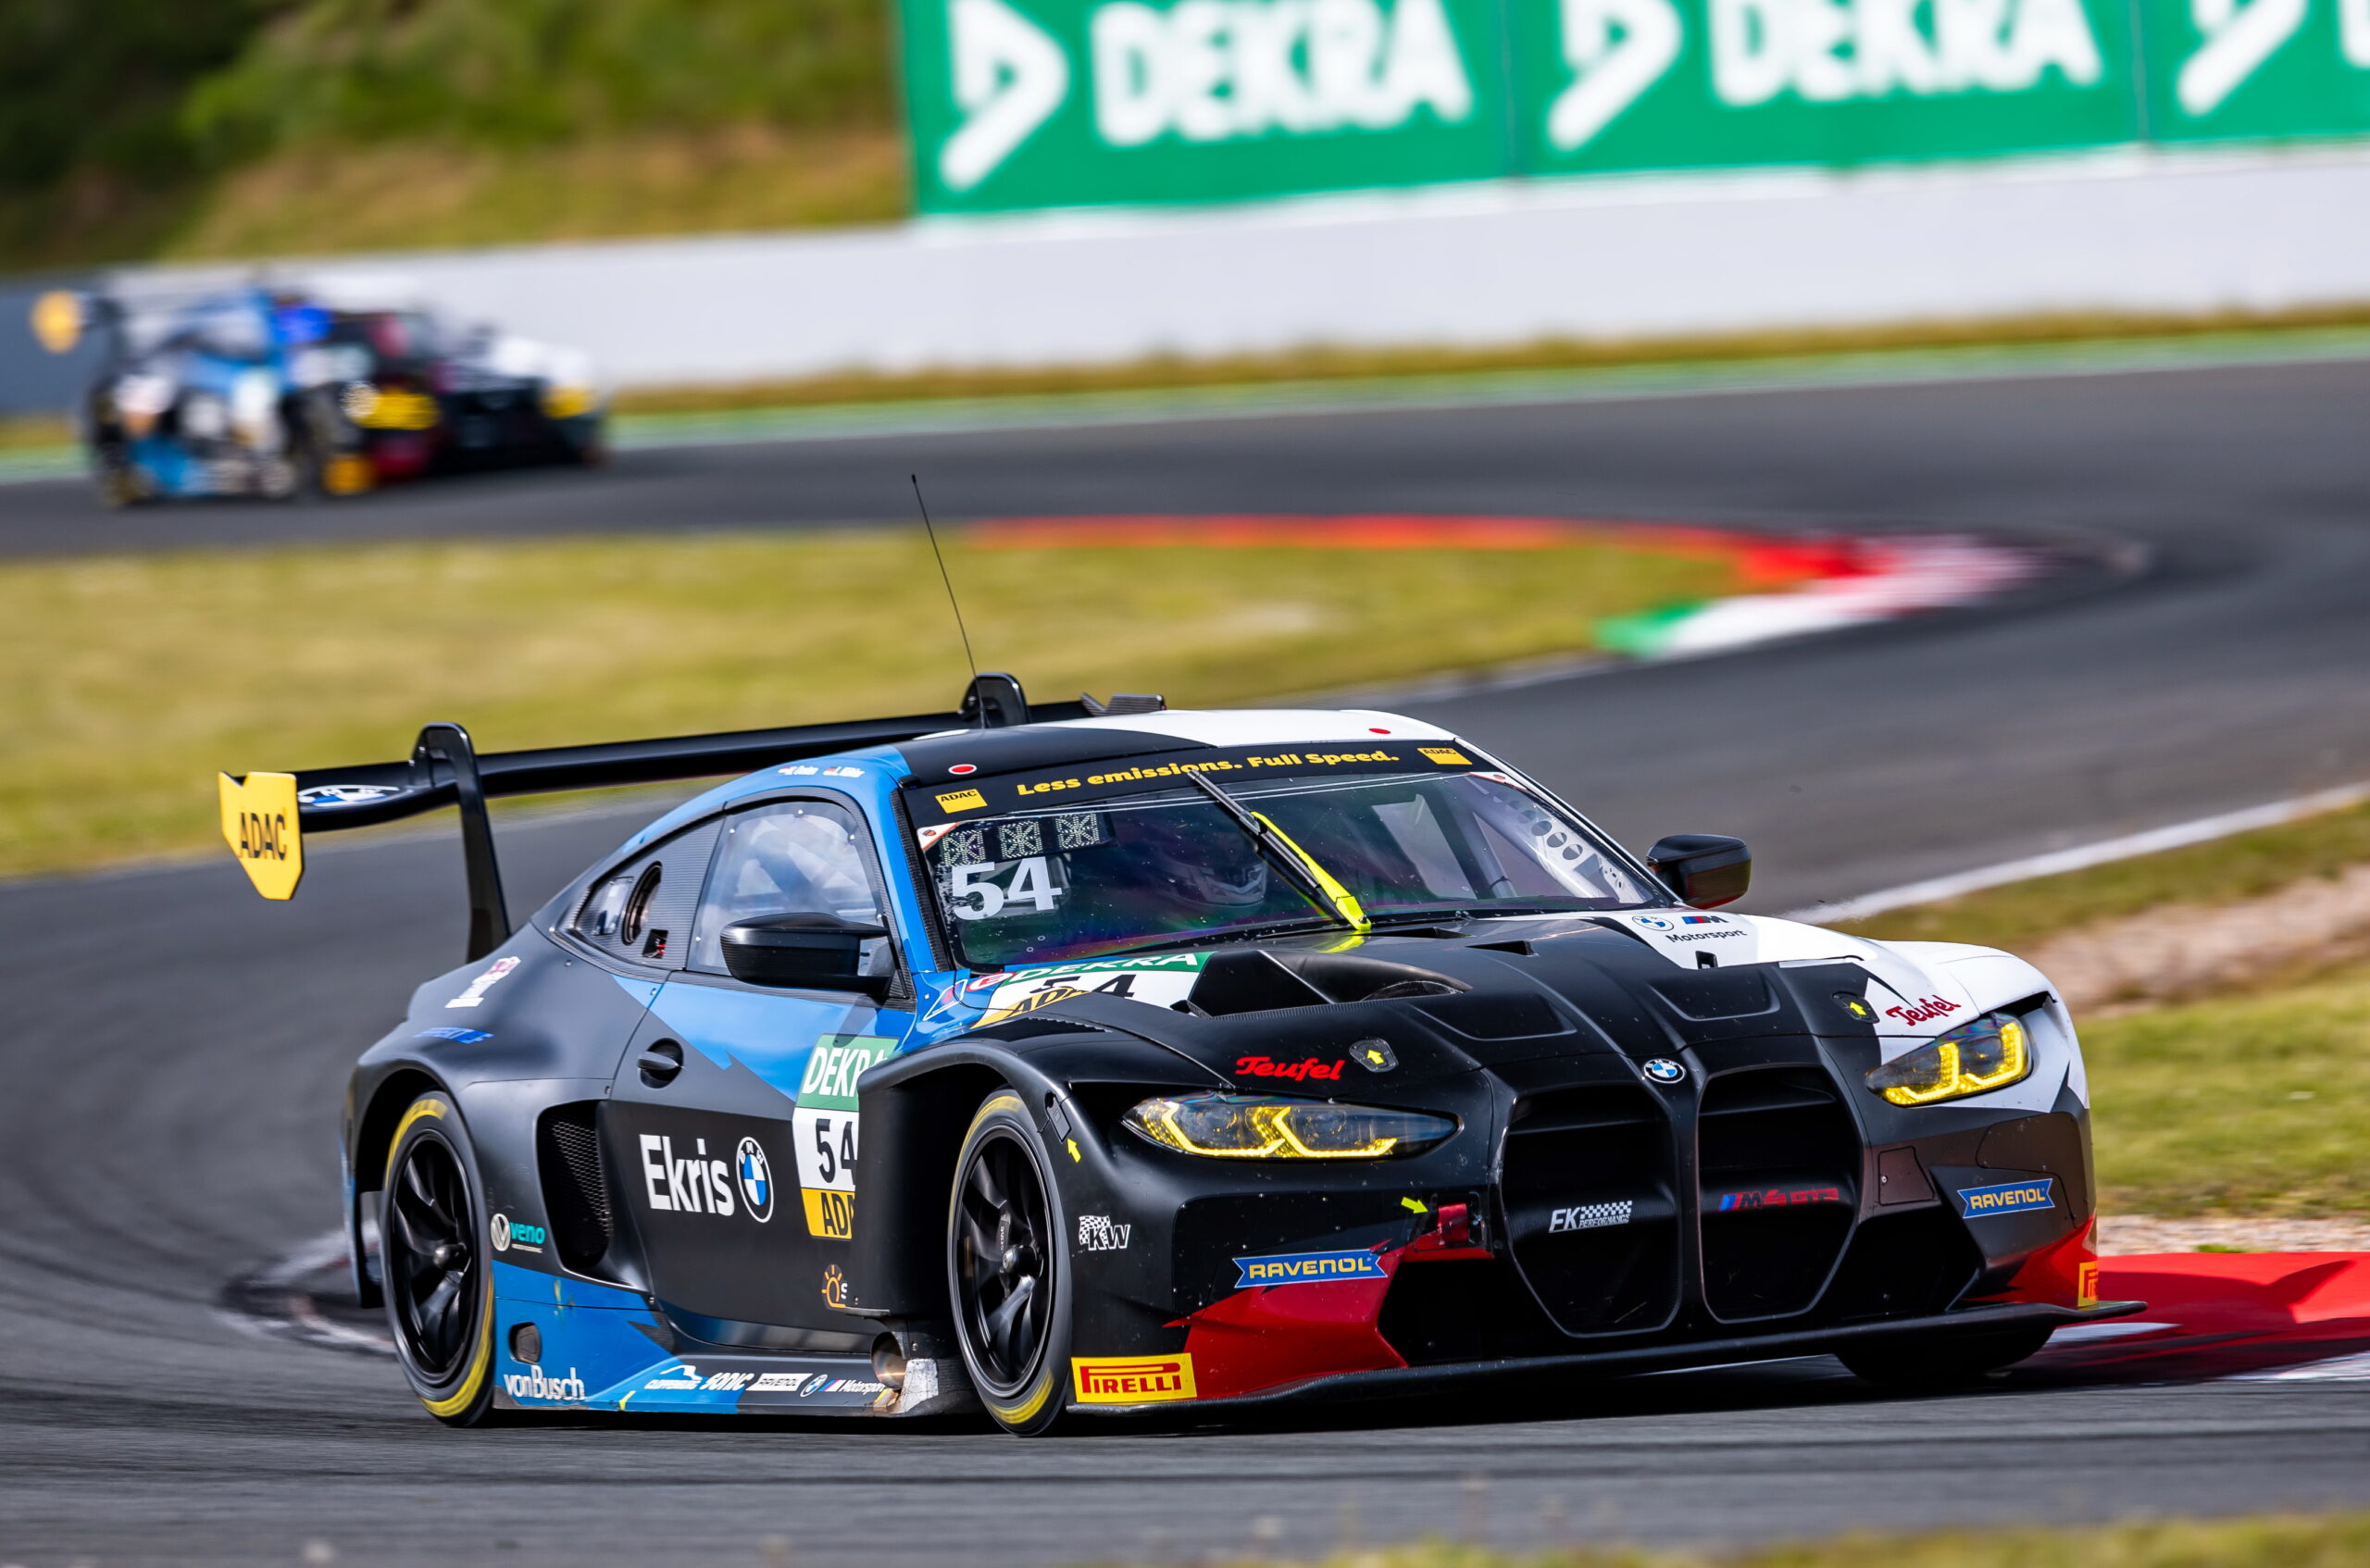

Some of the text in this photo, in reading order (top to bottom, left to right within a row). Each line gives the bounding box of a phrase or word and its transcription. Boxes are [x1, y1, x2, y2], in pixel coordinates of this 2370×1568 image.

[1709, 0, 2103, 106] DEKRA
[1091, 0, 1472, 144] DEKRA
[1016, 750, 1400, 796] Less emissions. Full Speed.
[940, 790, 979, 803] ADAC
[239, 812, 287, 862] ADAC
[952, 856, 1063, 921] 54
[1665, 929, 1748, 943] Motorsport
[1009, 952, 1198, 982] DEKRA
[1029, 973, 1137, 1000] 54
[1885, 994, 1961, 1027] Teufel
[801, 1046, 889, 1098] DEKR
[1235, 1056, 1346, 1081] Teufel
[816, 1118, 858, 1186] 54
[639, 1134, 735, 1216] Ekris
[1969, 1188, 2045, 1210] RAVENOL
[820, 1192, 855, 1237] AD
[1549, 1207, 1581, 1233] FK
[1579, 1213, 1630, 1228] PERFORMANCE
[1088, 1225, 1130, 1251] KW
[1250, 1257, 1372, 1279] RAVENOL
[503, 1364, 585, 1400] vonBusch
[838, 1380, 886, 1395] Motorspor
[1079, 1363, 1181, 1393] PIRELLI
